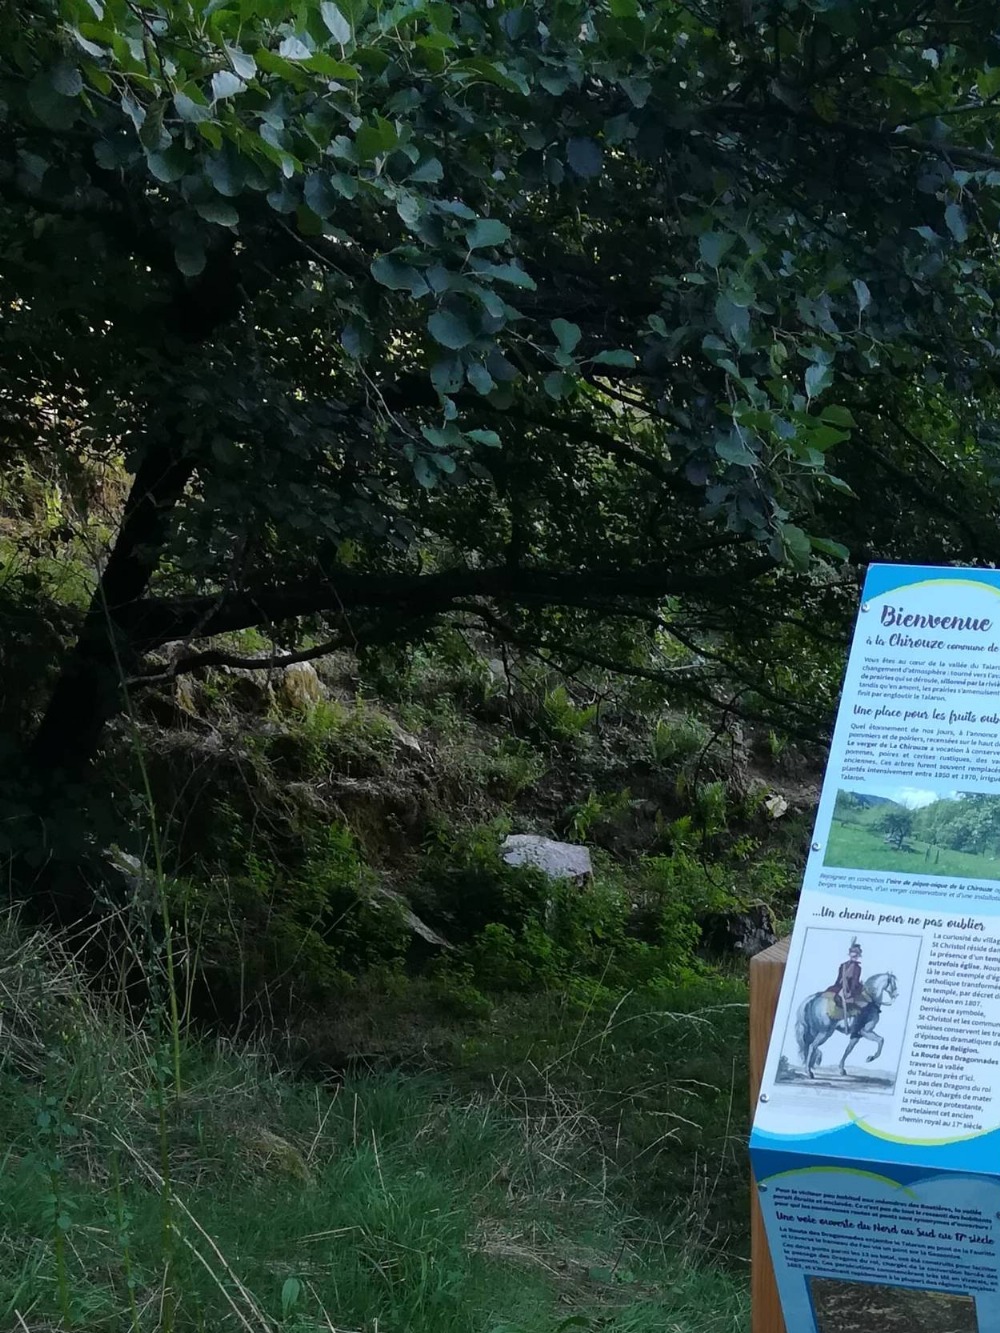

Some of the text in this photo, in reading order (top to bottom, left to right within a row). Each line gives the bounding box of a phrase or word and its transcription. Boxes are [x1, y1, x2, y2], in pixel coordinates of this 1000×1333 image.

[880, 605, 992, 632] Bienvenue
[866, 636, 872, 645] à
[875, 634, 885, 646] la
[889, 633, 944, 649] Chirouze
[987, 642, 999, 652] de
[853, 704, 873, 716] Une
[874, 705, 902, 720] place
[903, 710, 928, 722] pour
[932, 708, 946, 721] les
[948, 710, 976, 725] fruits
[838, 907, 875, 922] chemin
[877, 914, 904, 925] pour
[907, 917, 921, 925] ne
[922, 918, 943, 929] pas
[946, 917, 985, 932] oublier
